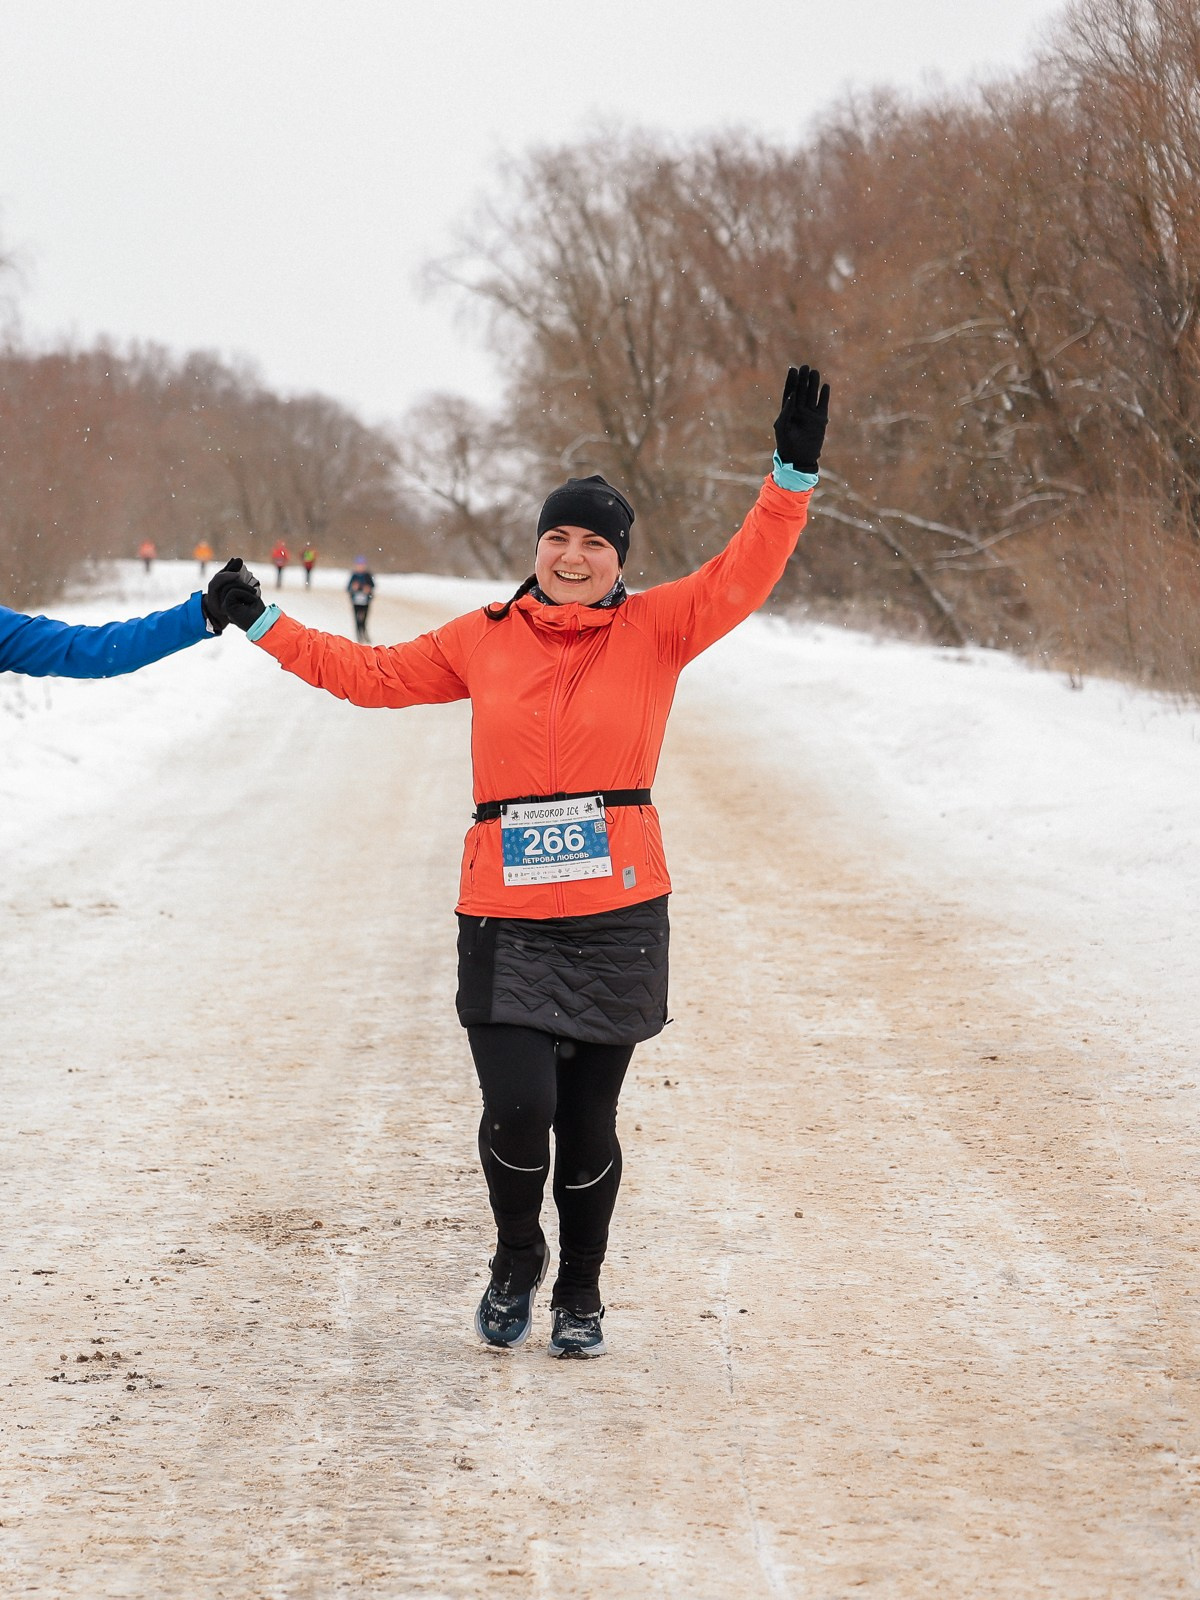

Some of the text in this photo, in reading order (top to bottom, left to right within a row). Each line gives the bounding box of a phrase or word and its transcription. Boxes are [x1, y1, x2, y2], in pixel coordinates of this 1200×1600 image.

[523, 807, 565, 820] NOVGOROD
[566, 806, 579, 816] ICE
[523, 825, 585, 856] 266
[522, 852, 590, 864] ПЕТРОВА ЛЮБОВЬ
